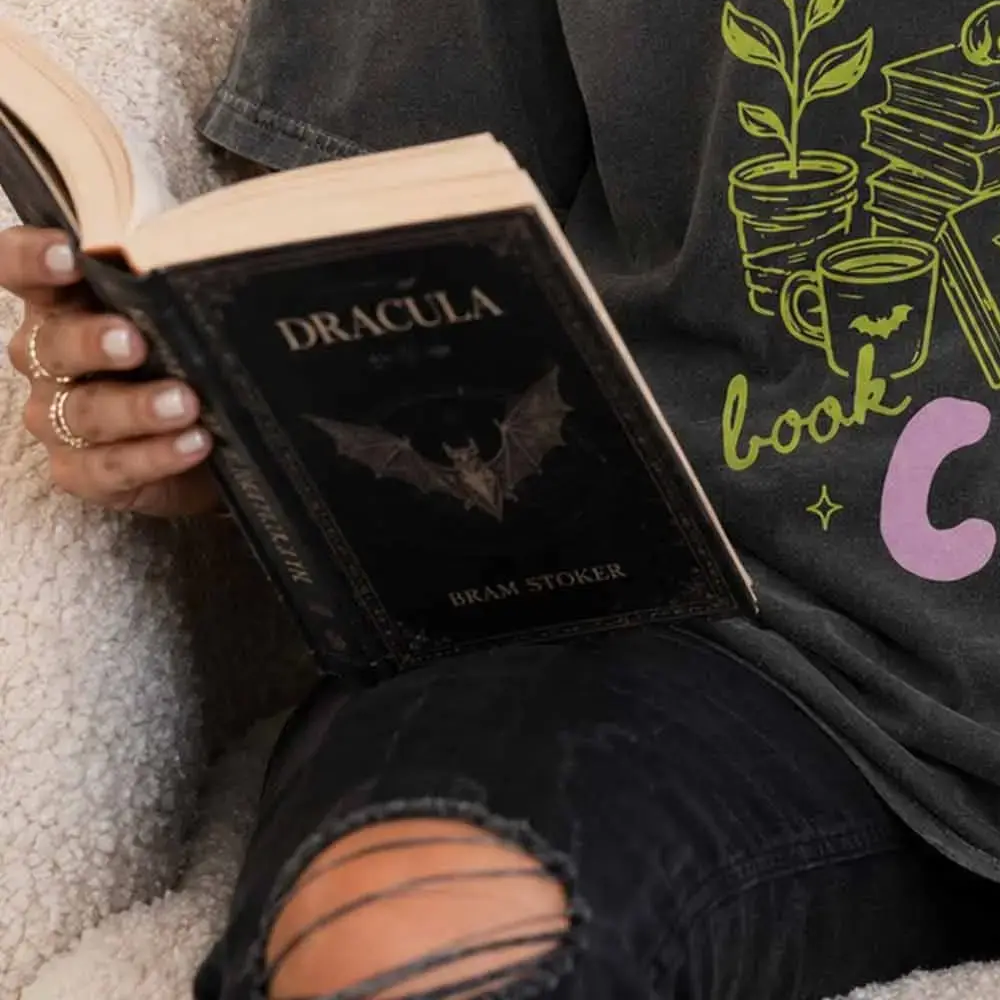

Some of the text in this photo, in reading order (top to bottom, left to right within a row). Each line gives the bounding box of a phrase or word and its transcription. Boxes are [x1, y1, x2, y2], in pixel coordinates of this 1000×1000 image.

[275, 285, 504, 351] DRACULA
[722, 343, 912, 471] book
[449, 562, 627, 607] BRAM STOKER
